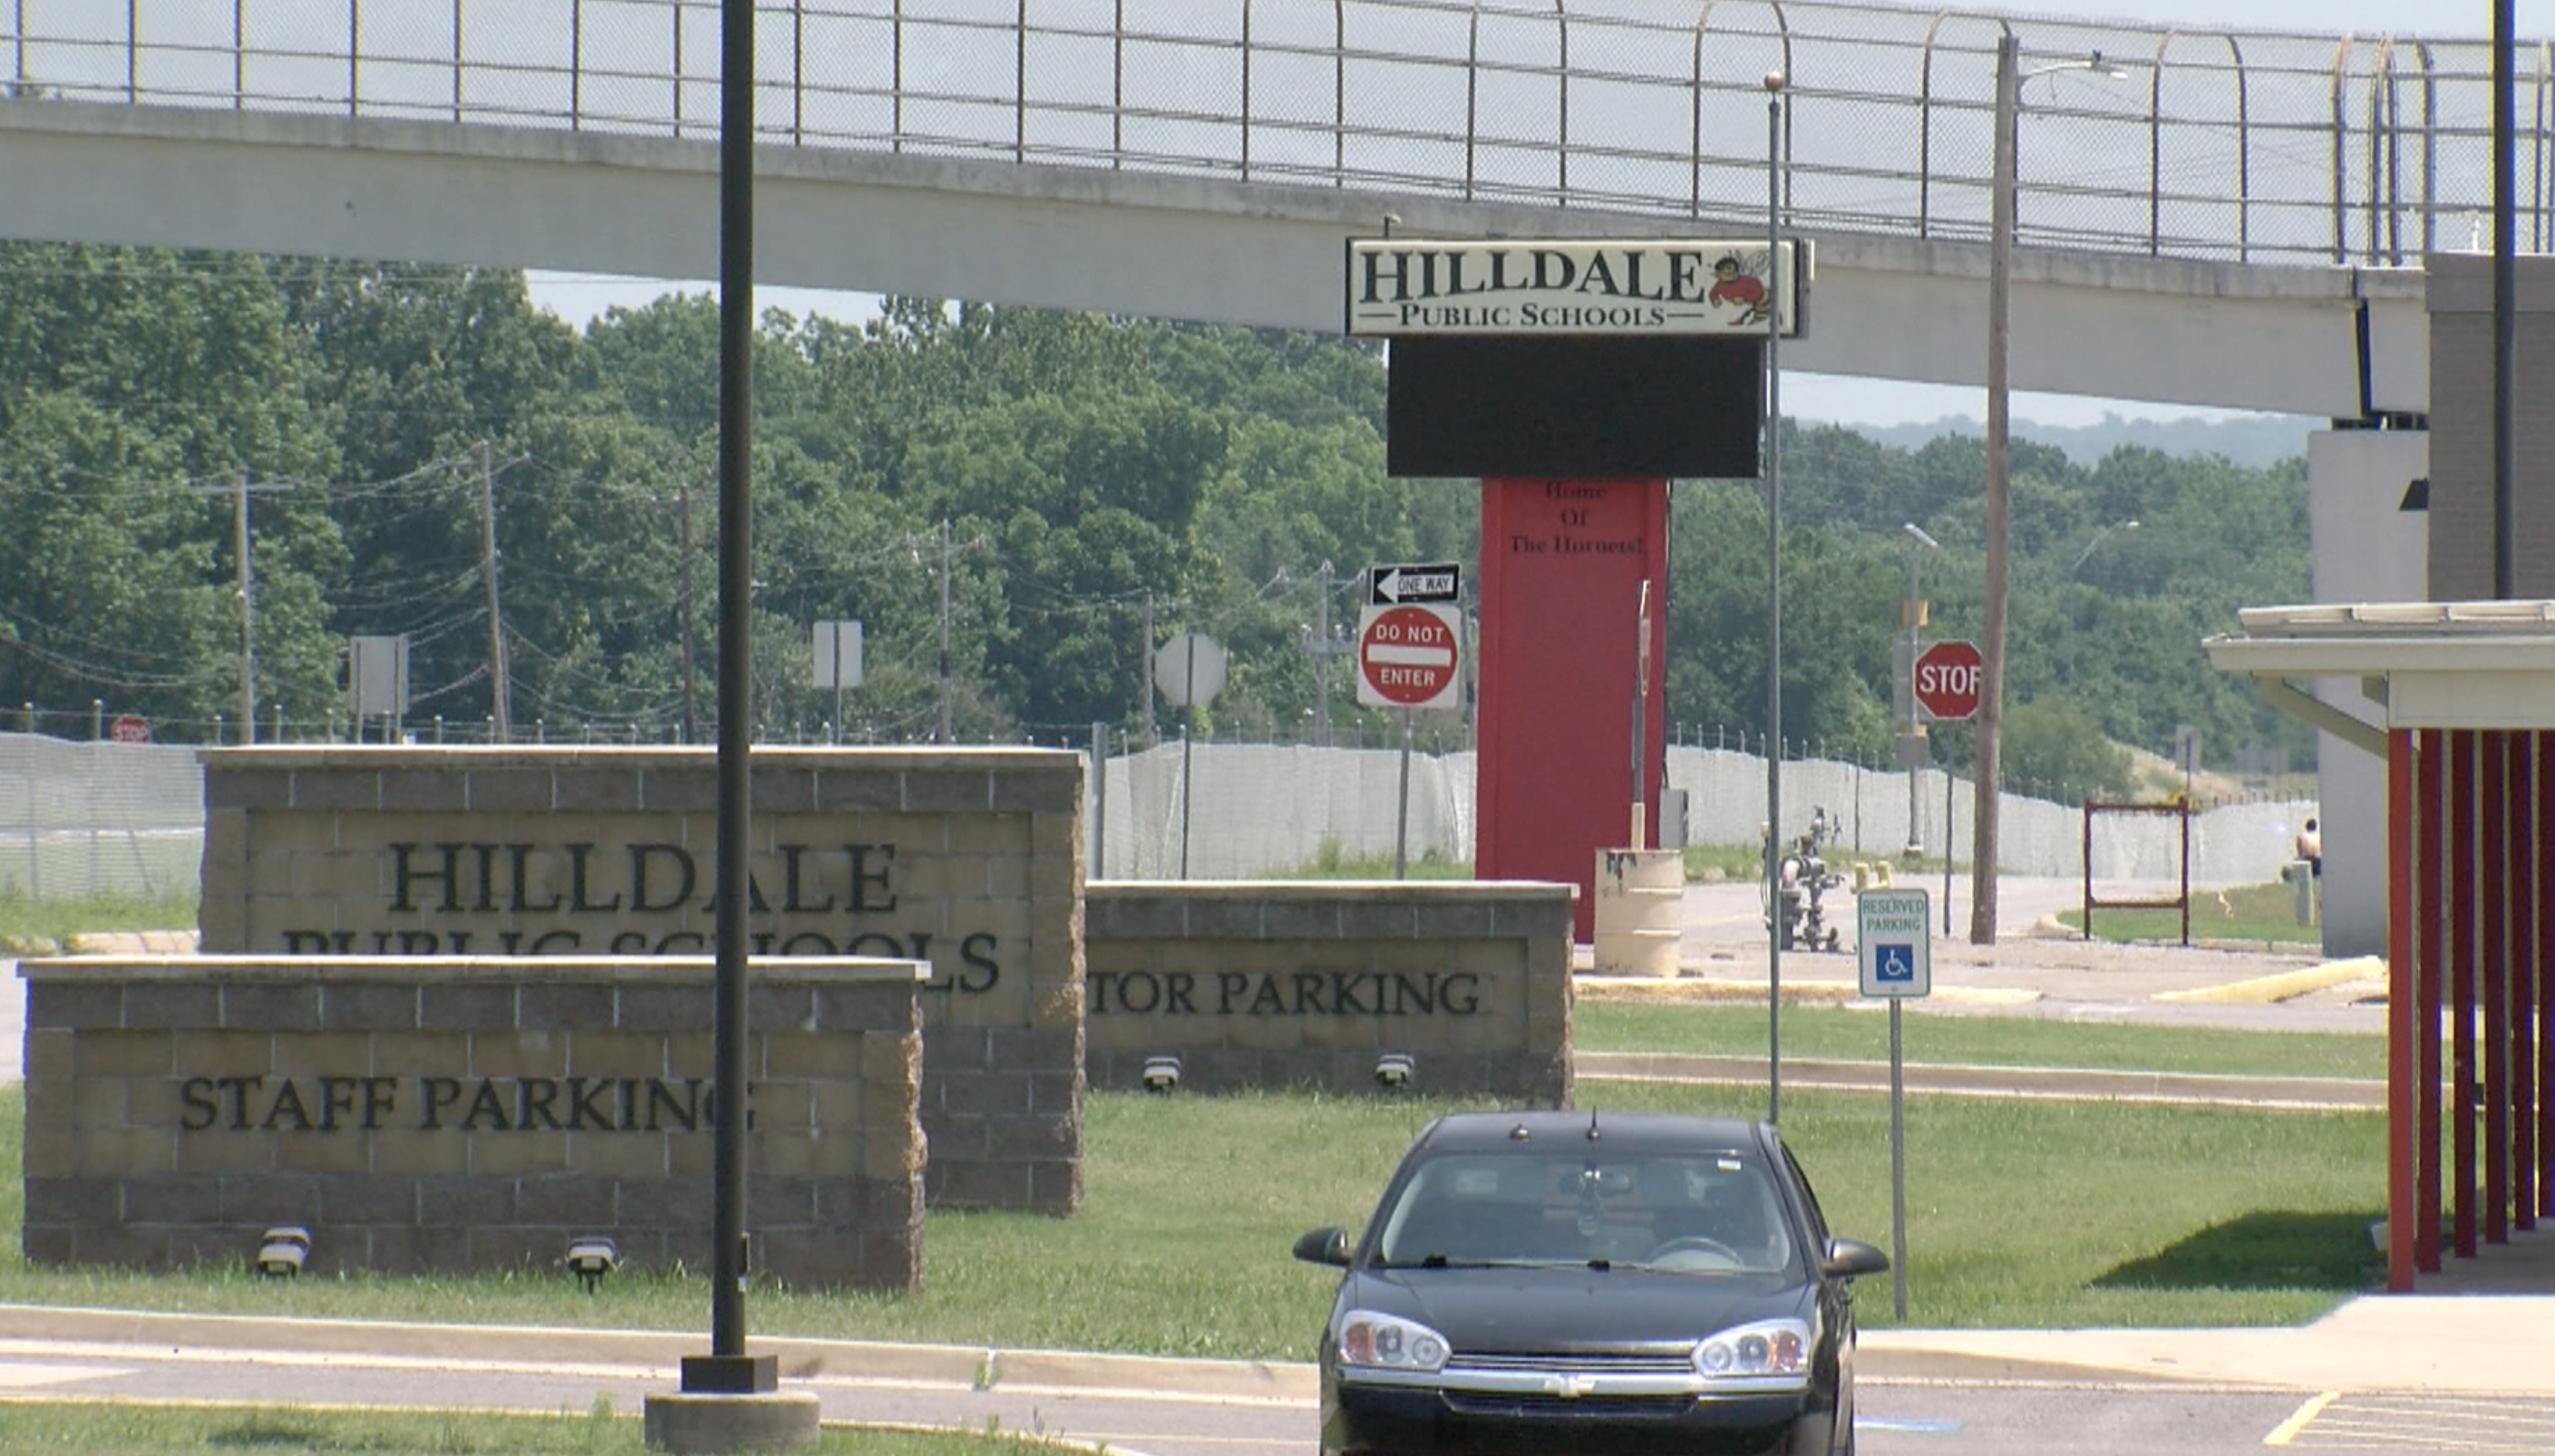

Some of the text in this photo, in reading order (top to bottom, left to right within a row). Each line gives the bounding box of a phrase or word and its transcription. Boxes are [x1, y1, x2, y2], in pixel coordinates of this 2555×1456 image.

[1358, 248, 1705, 304] HILLDALE
[1399, 302, 1665, 327] PUBLIC SCHOOLS
[1545, 481, 1605, 499] Home
[1560, 510, 1589, 527] Of
[1511, 535, 1546, 553] The
[1398, 577, 1450, 594] ONE WAY
[1376, 624, 1444, 644] DO NOT
[1380, 667, 1435, 687] ENTER
[1862, 899, 1925, 914] RESERVED
[1867, 917, 1920, 932] PARKING
[1216, 971, 1479, 1015] PARKING
[181, 1076, 399, 1131] STAFF
